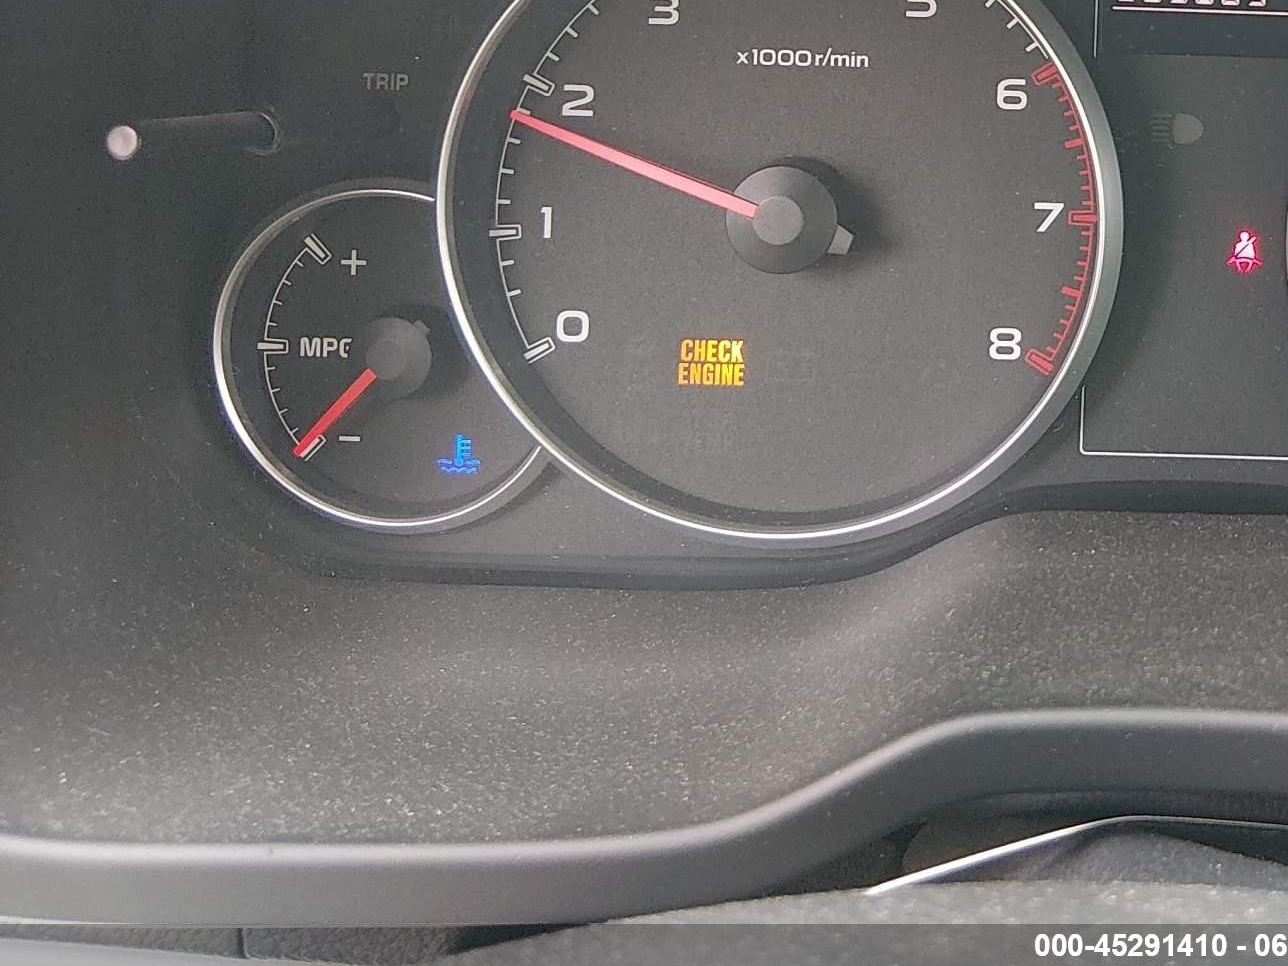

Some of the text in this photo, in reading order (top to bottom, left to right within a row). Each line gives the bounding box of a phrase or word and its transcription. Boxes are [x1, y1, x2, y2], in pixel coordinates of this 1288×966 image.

[737, 48, 868, 67] x1000 r/min
[363, 73, 408, 90] TRIP
[997, 79, 1027, 109] 6
[562, 85, 594, 116] 2
[541, 207, 552, 238] 1
[1035, 203, 1064, 232] 7
[557, 311, 589, 342] 0
[681, 340, 743, 362] CHECK
[990, 328, 1021, 359] 8
[679, 363, 745, 386] ENGINE
